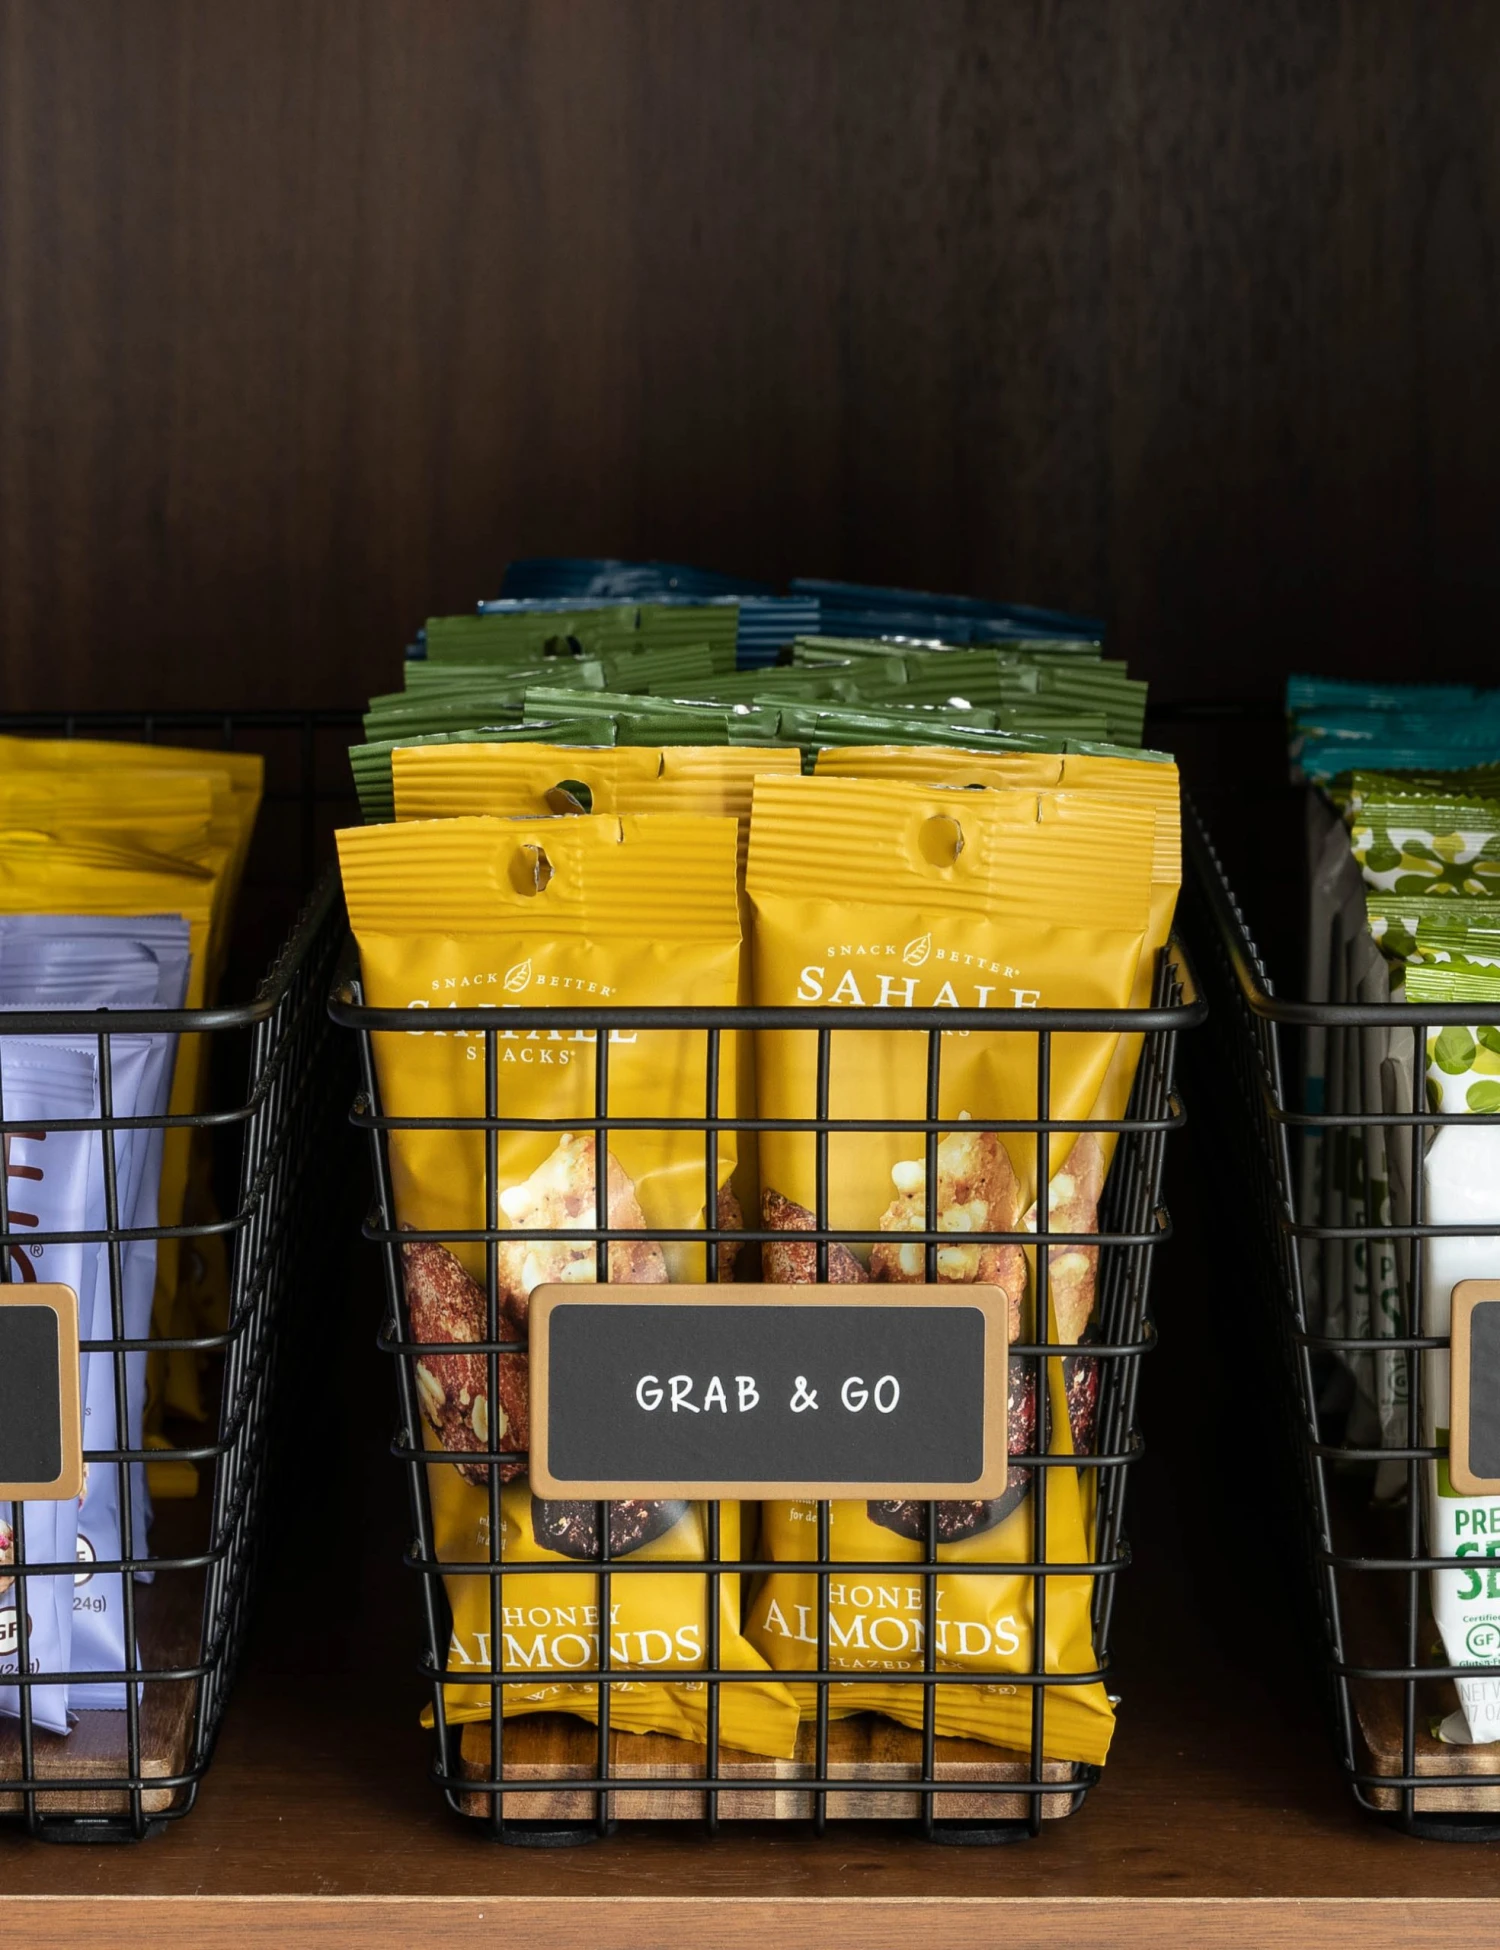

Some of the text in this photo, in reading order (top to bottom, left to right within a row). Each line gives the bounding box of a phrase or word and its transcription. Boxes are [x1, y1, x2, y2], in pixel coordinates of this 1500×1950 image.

[827, 945, 896, 957] SNACK
[431, 973, 498, 990] SNACK
[466, 1046, 569, 1065] SACKS
[636, 1375, 900, 1413] GRAB & GO
[789, 1507, 804, 1521] for
[763, 1598, 1020, 1656] ALMONDS
[1473, 1633, 1494, 1647] GF
[1460, 1681, 1487, 1702] NET
